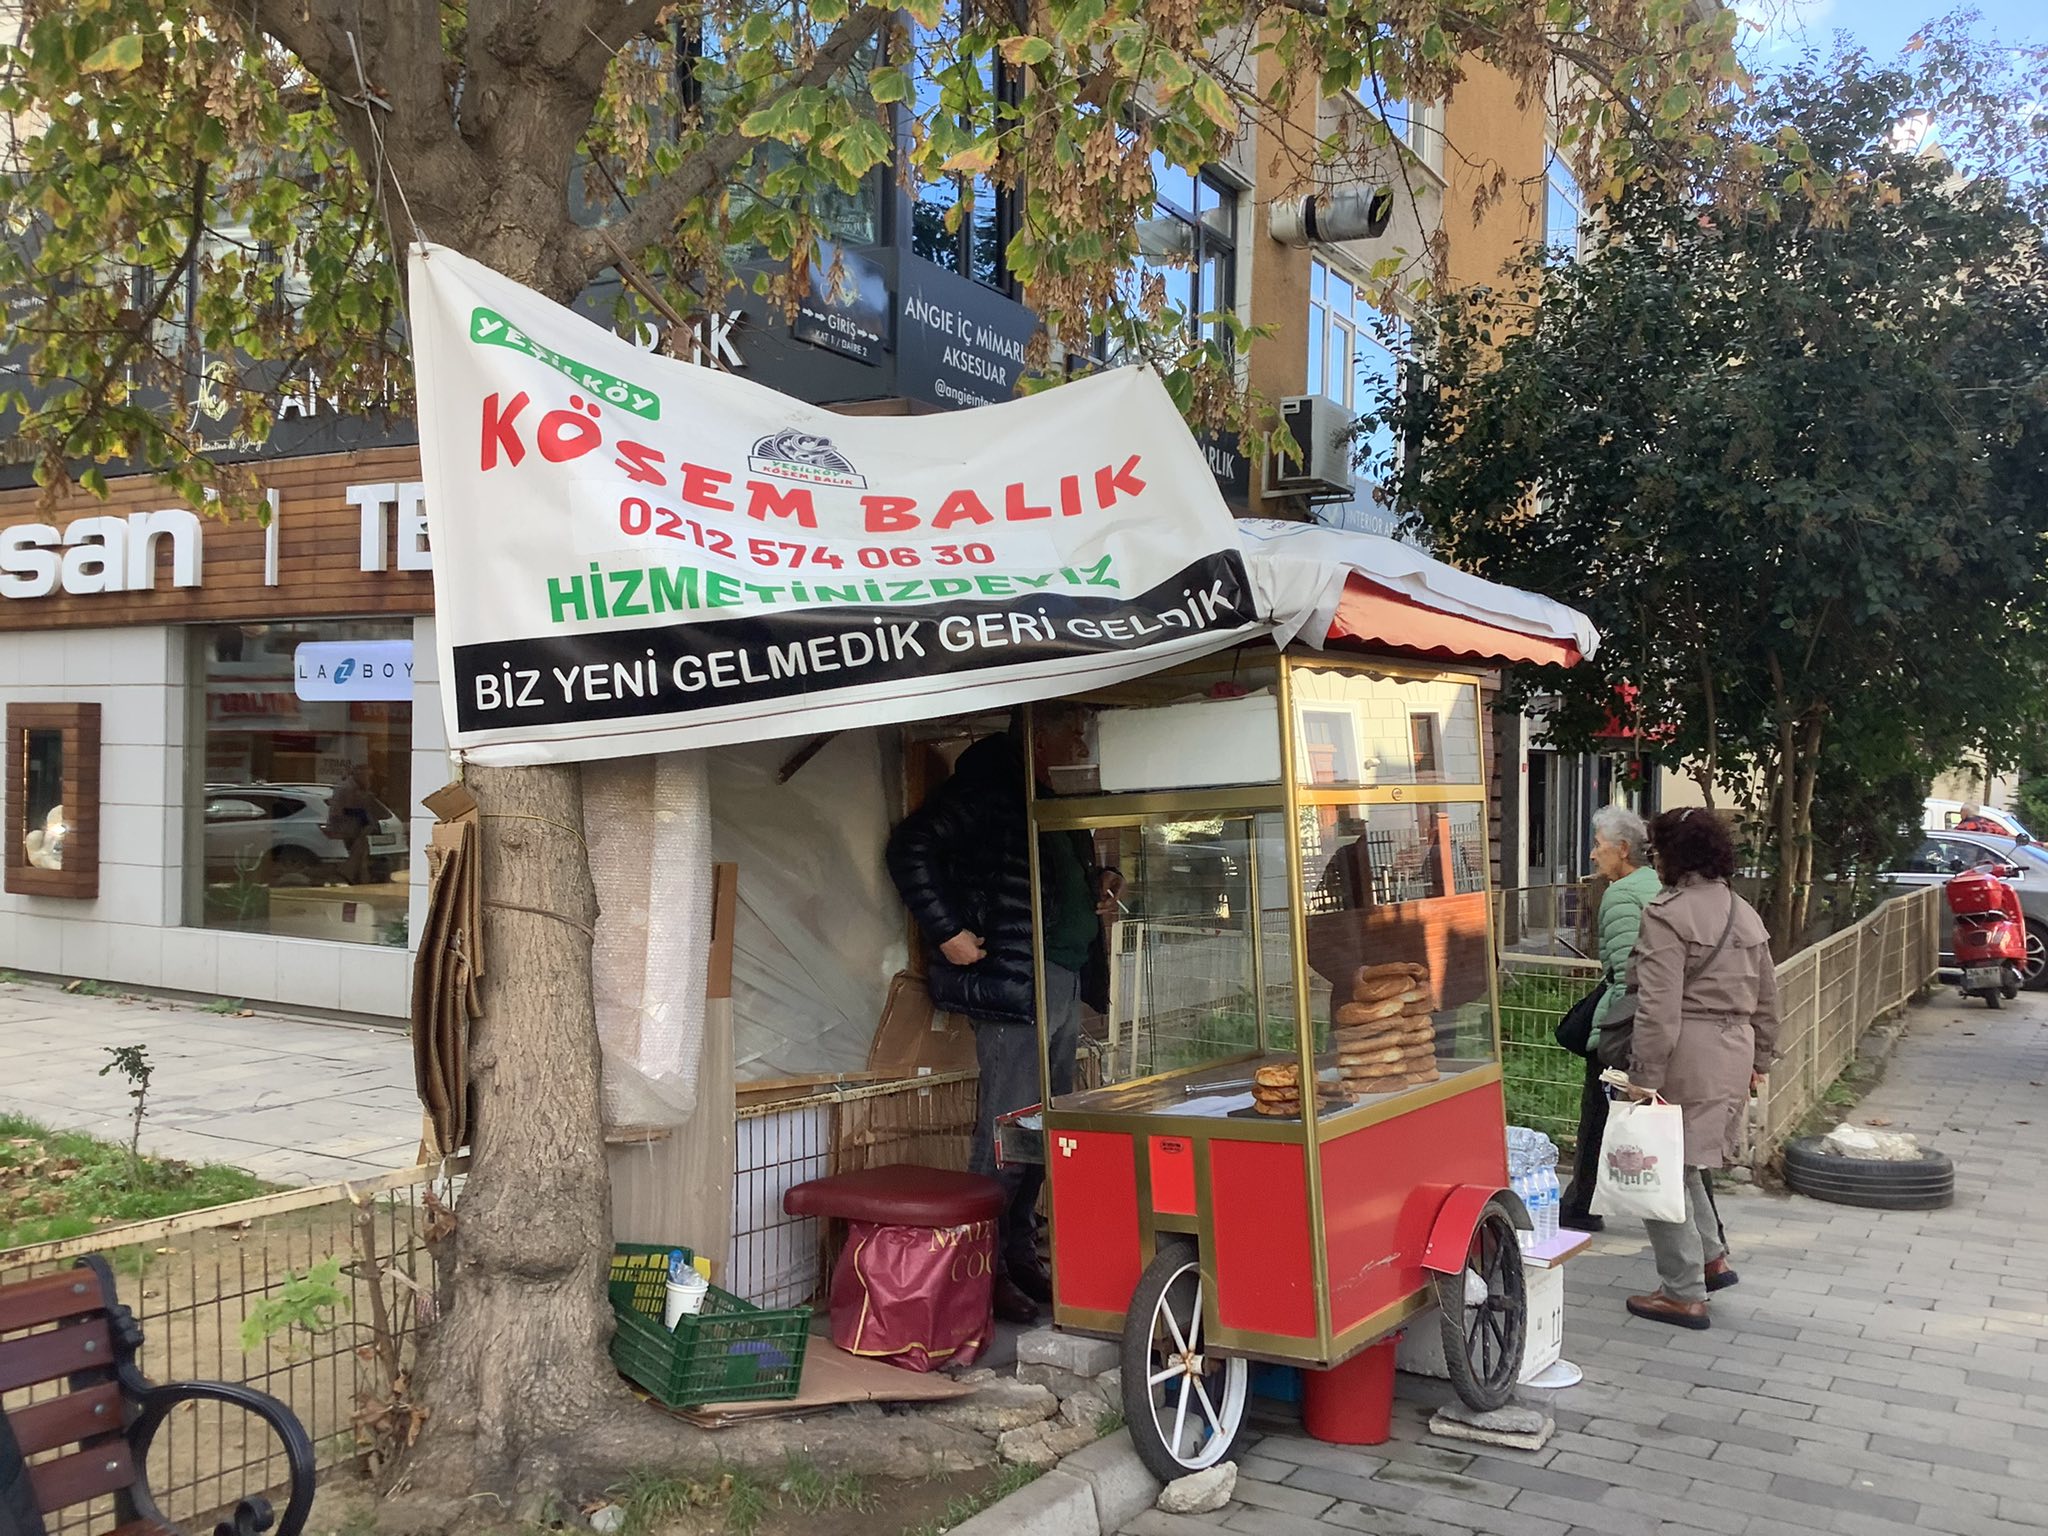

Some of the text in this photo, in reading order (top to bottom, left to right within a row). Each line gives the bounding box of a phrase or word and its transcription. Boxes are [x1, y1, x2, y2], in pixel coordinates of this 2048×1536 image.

[827, 312, 857, 340] GİRİŞ
[904, 296, 953, 335] ANGIE
[957, 311, 973, 346] İÇ
[475, 315, 656, 412] YEŞİLKÖY
[942, 345, 1007, 387] AKSESUAR
[480, 390, 1148, 533] KÖŞEM BALIK
[814, 475, 854, 486] BALIK
[0, 508, 202, 599] san
[619, 497, 996, 570] 0212 574 06 30
[474, 579, 1236, 711] BİZ YENİ GELMEDİK GERİ GELDİK
